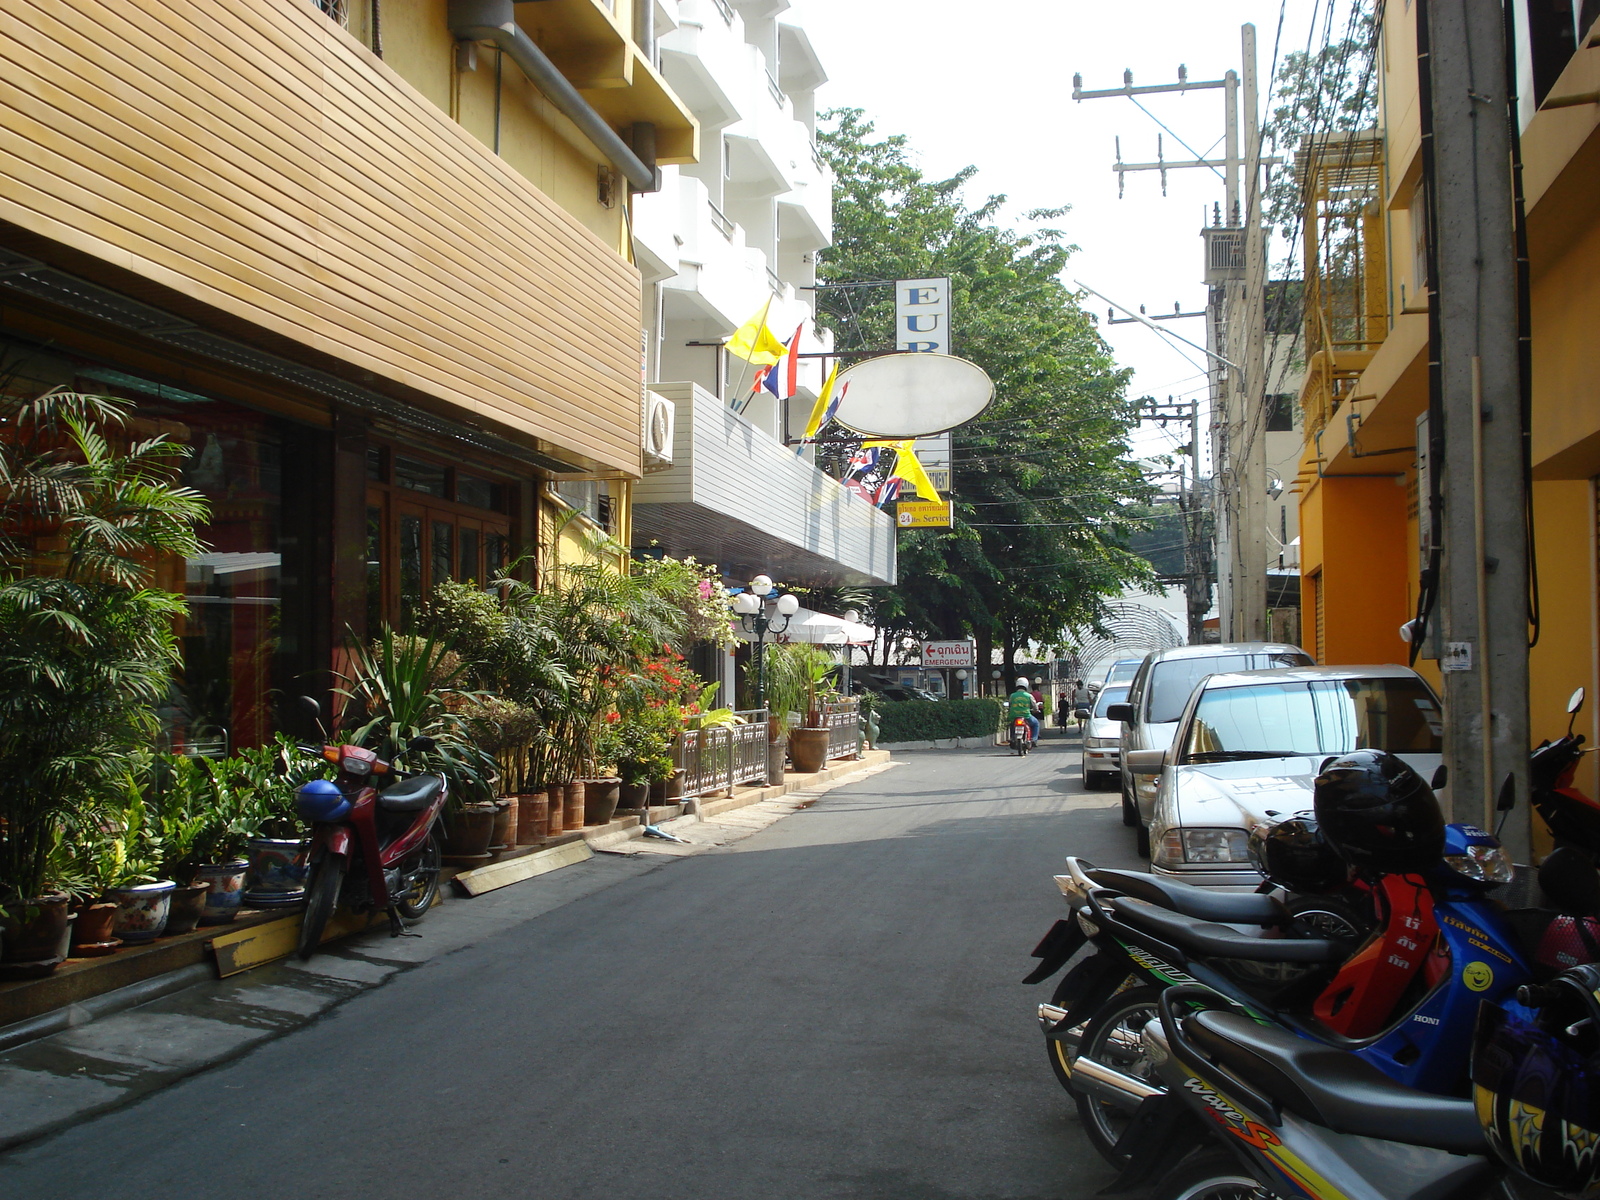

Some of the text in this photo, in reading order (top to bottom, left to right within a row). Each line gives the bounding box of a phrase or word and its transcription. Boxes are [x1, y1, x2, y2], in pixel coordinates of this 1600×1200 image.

[900, 514, 911, 523] 24
[923, 513, 950, 522] Service
[937, 644, 969, 658] ฉุกเฉิน
[1128, 954, 1153, 969] 100
[1183, 1077, 1283, 1150] Wave S
